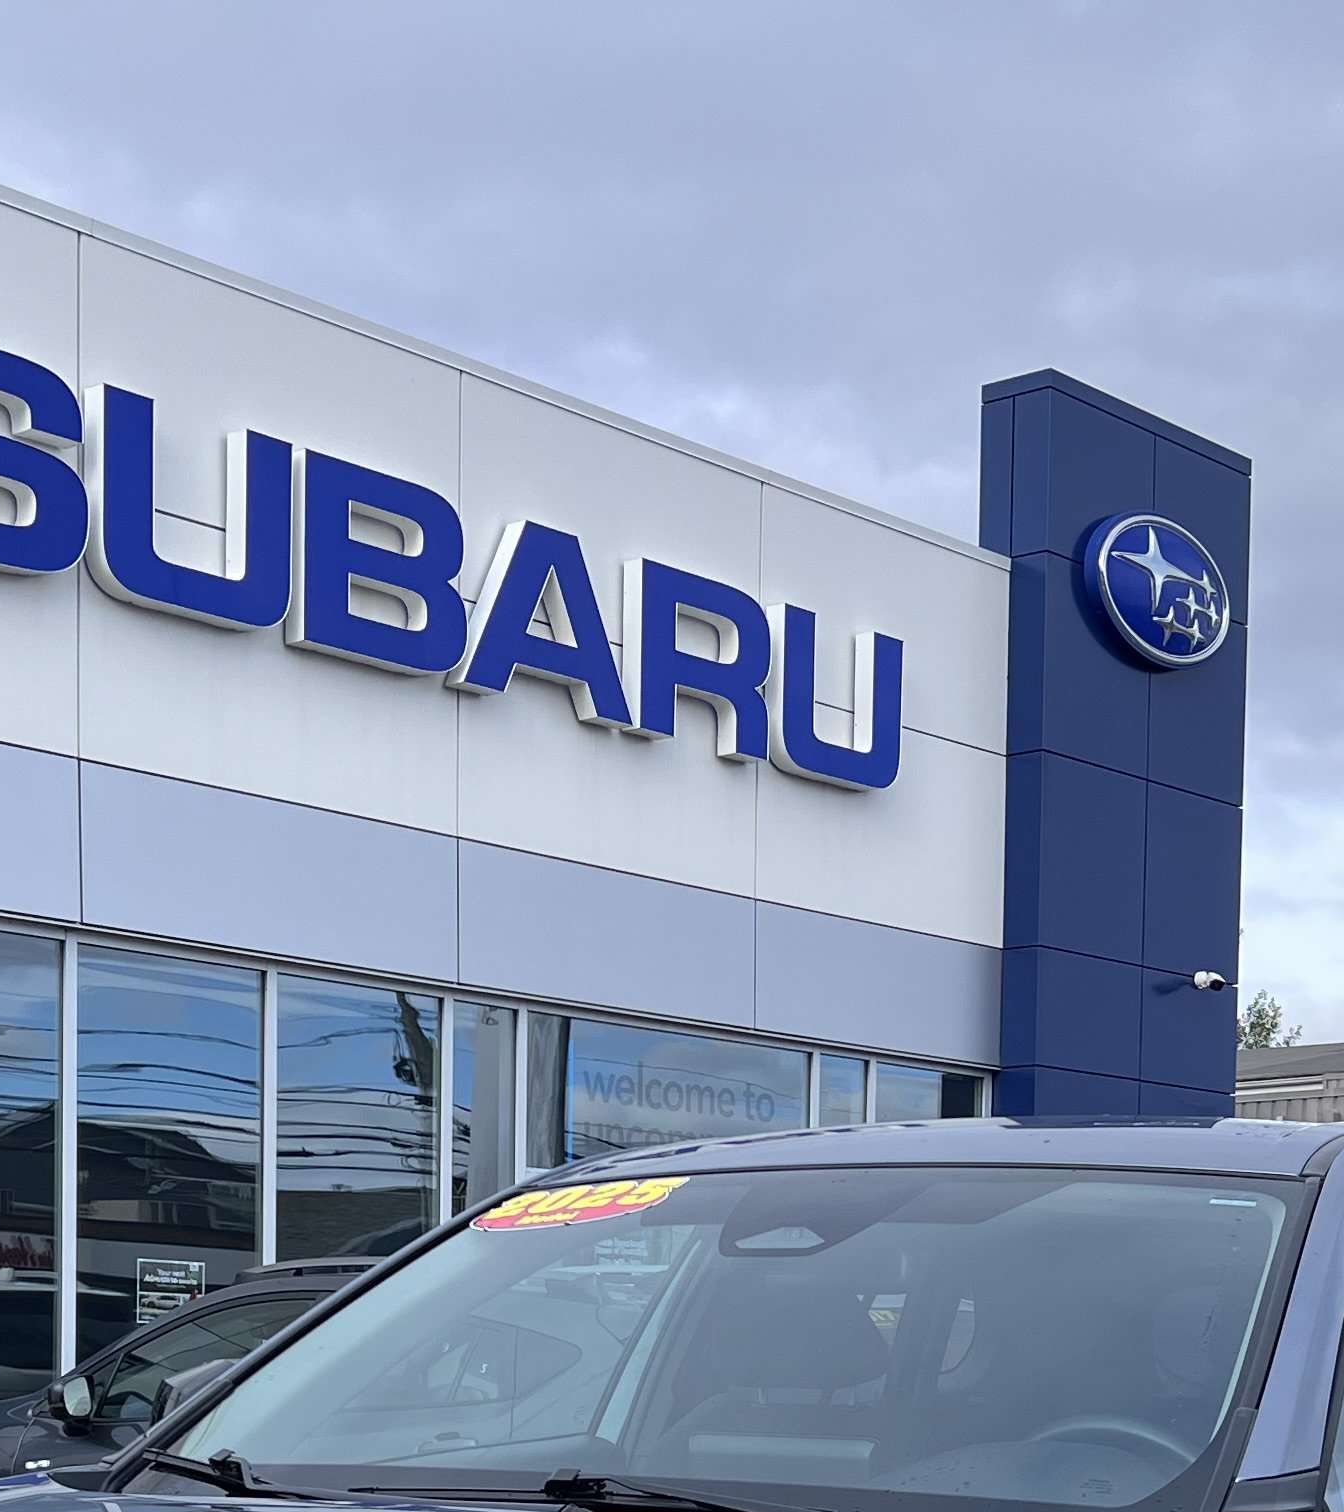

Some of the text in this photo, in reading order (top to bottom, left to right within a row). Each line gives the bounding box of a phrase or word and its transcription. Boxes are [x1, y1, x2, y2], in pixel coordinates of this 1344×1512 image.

[582, 1060, 776, 1123] welcome to
[482, 1176, 691, 1220] 2025
